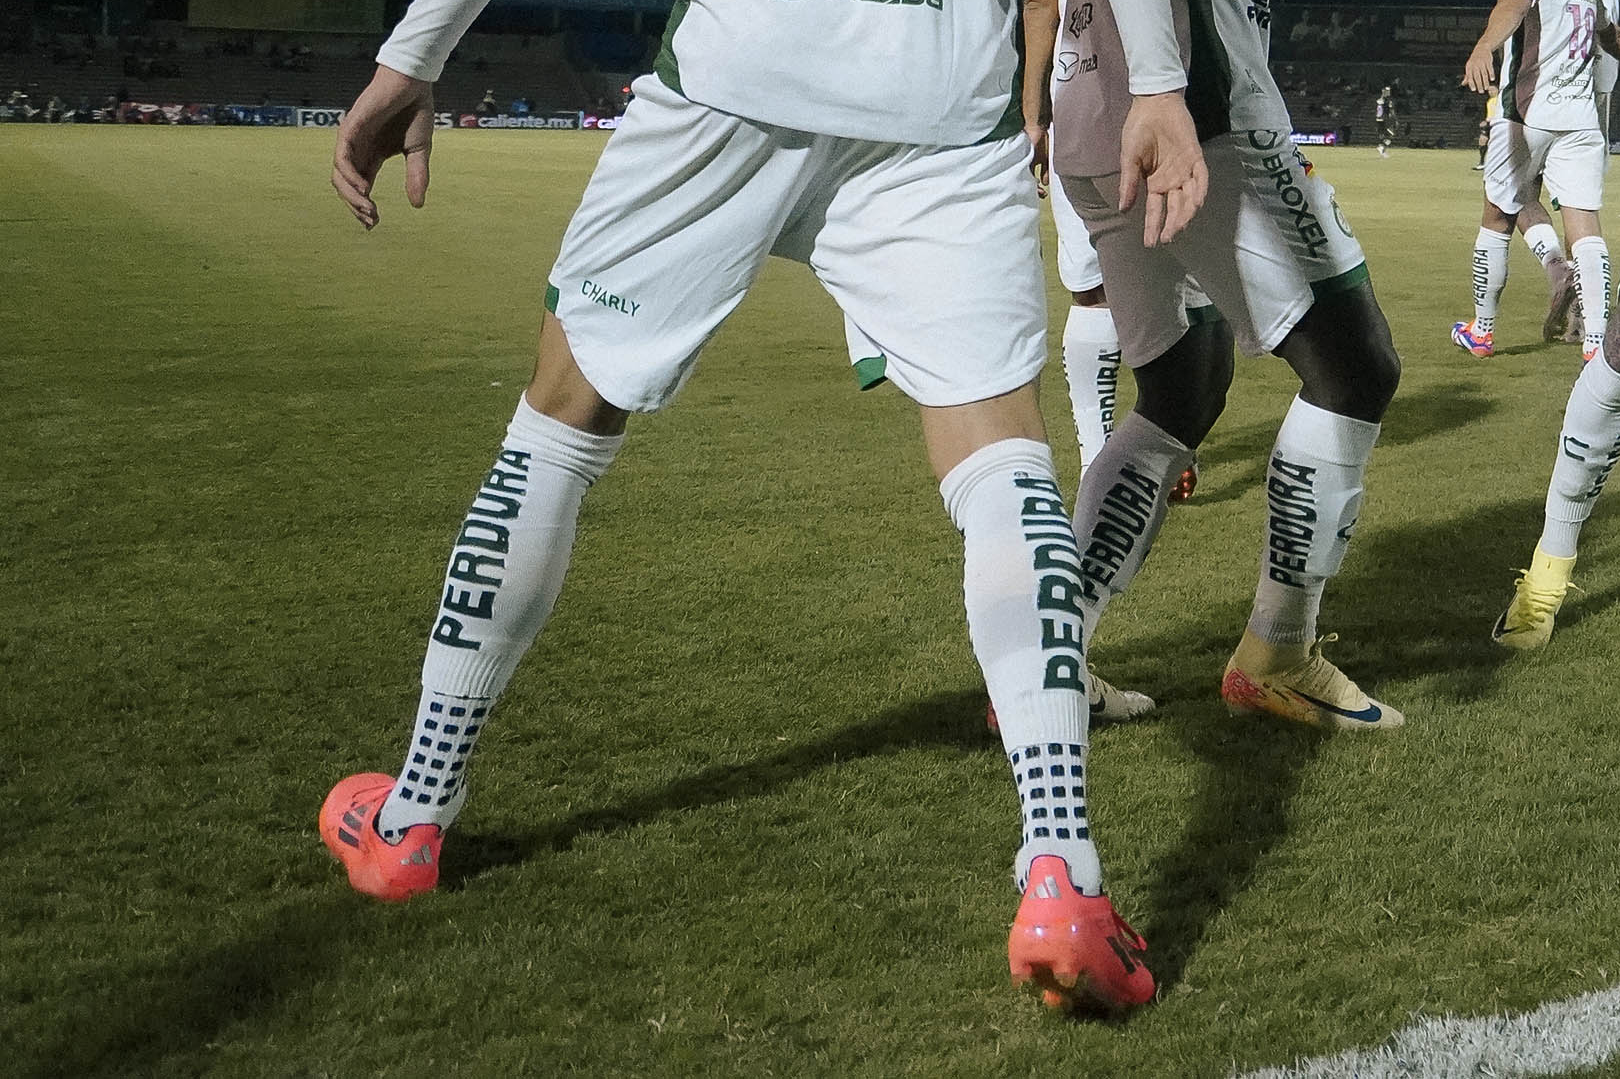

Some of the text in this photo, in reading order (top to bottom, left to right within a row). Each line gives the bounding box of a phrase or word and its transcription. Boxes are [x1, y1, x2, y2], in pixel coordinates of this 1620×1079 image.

[477, 113, 575, 129] caliente.mx
[1261, 152, 1329, 259] BROXEL
[580, 279, 641, 317] CHARLY
[1472, 249, 1489, 307] PERDURA
[432, 448, 532, 652] PERDURA
[1267, 456, 1319, 589] PERDURA
